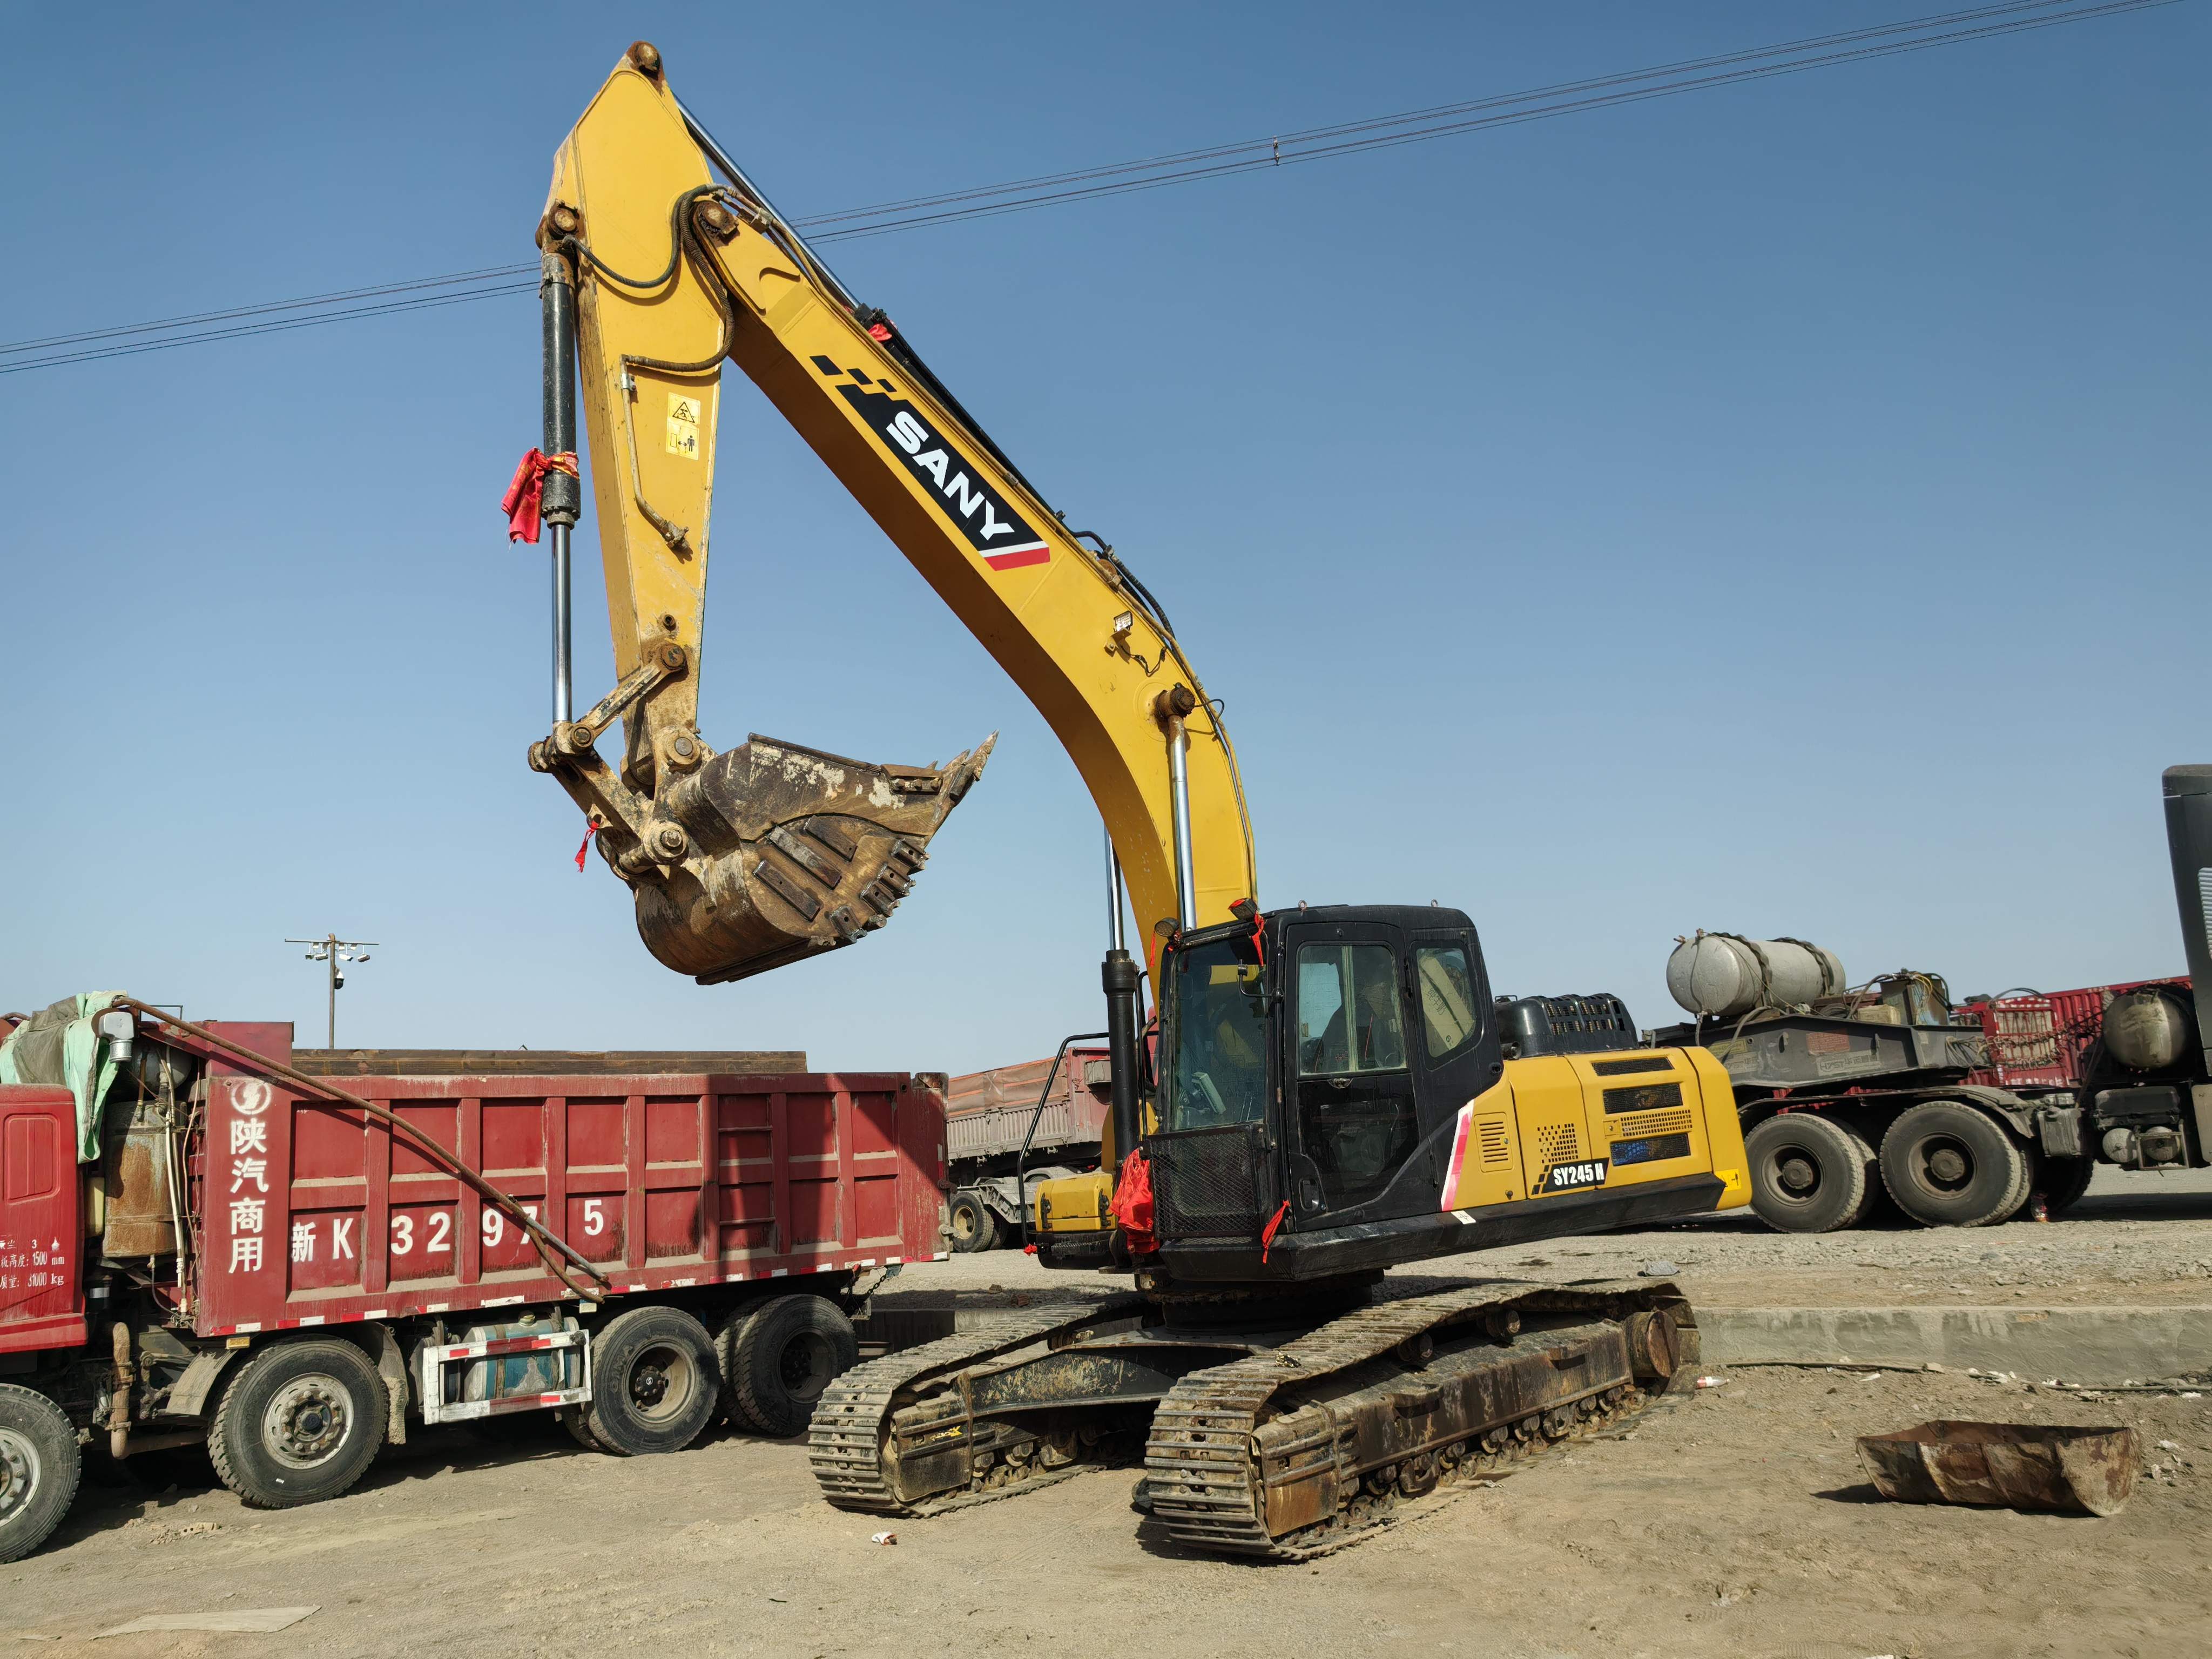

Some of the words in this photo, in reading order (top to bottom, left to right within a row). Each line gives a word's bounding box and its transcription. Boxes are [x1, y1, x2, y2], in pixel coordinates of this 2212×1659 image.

[886, 410, 1015, 541] SANY
[228, 1117, 269, 1274] 陕汽商用
[31, 1239, 37, 1249] 3
[32, 1251, 48, 1266] 1500
[51, 1256, 65, 1265] mm
[28, 1271, 47, 1287] 31000
[50, 1272, 64, 1286] kg
